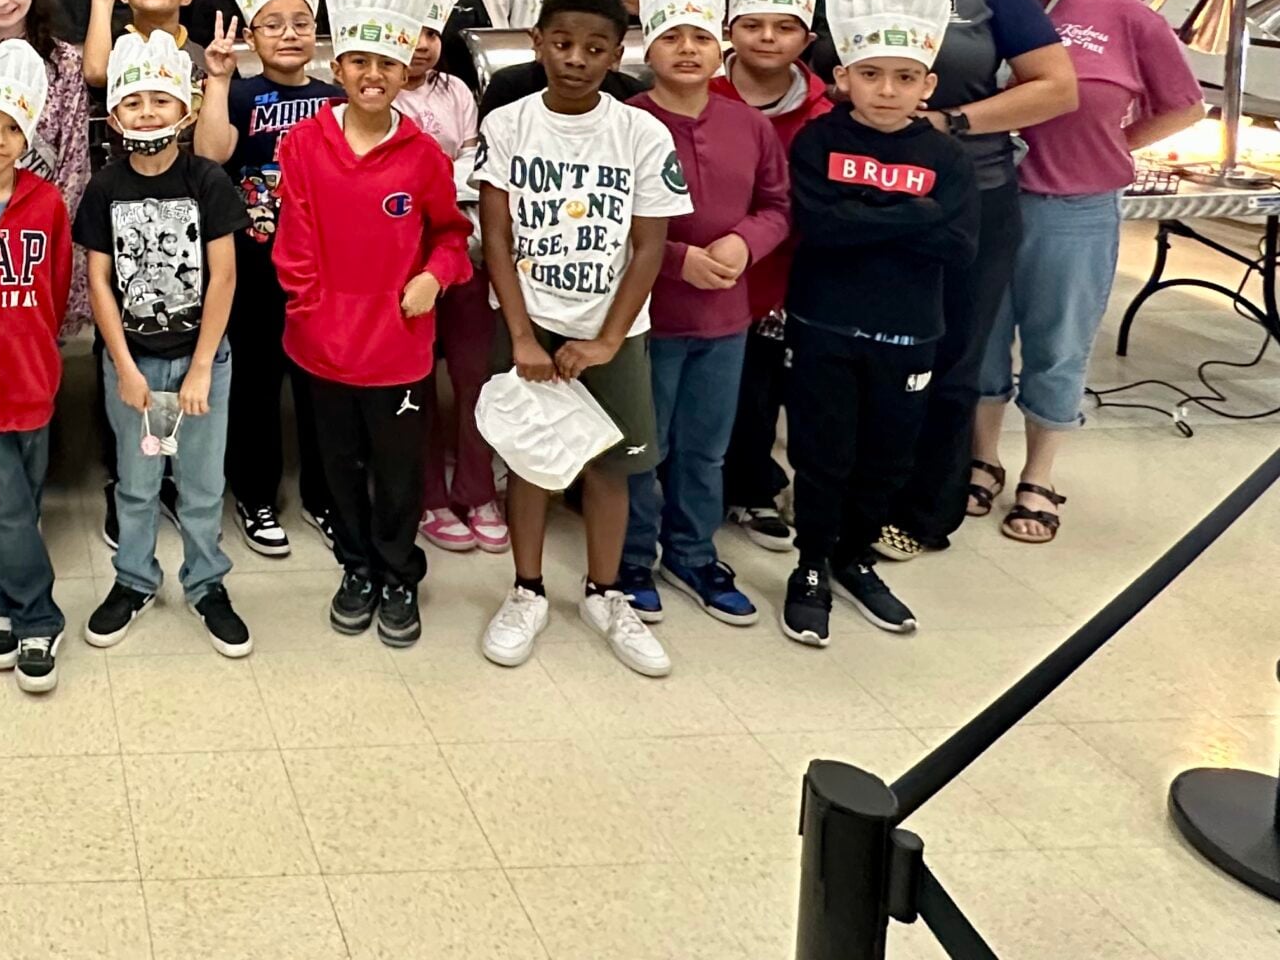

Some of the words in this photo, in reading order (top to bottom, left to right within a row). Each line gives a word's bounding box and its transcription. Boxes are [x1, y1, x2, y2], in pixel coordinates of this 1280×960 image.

[1082, 41, 1105, 55] FREE
[509, 155, 589, 193] DON'T
[596, 165, 631, 195] BE
[842, 158, 925, 192] BRUH
[575, 225, 607, 252] BE
